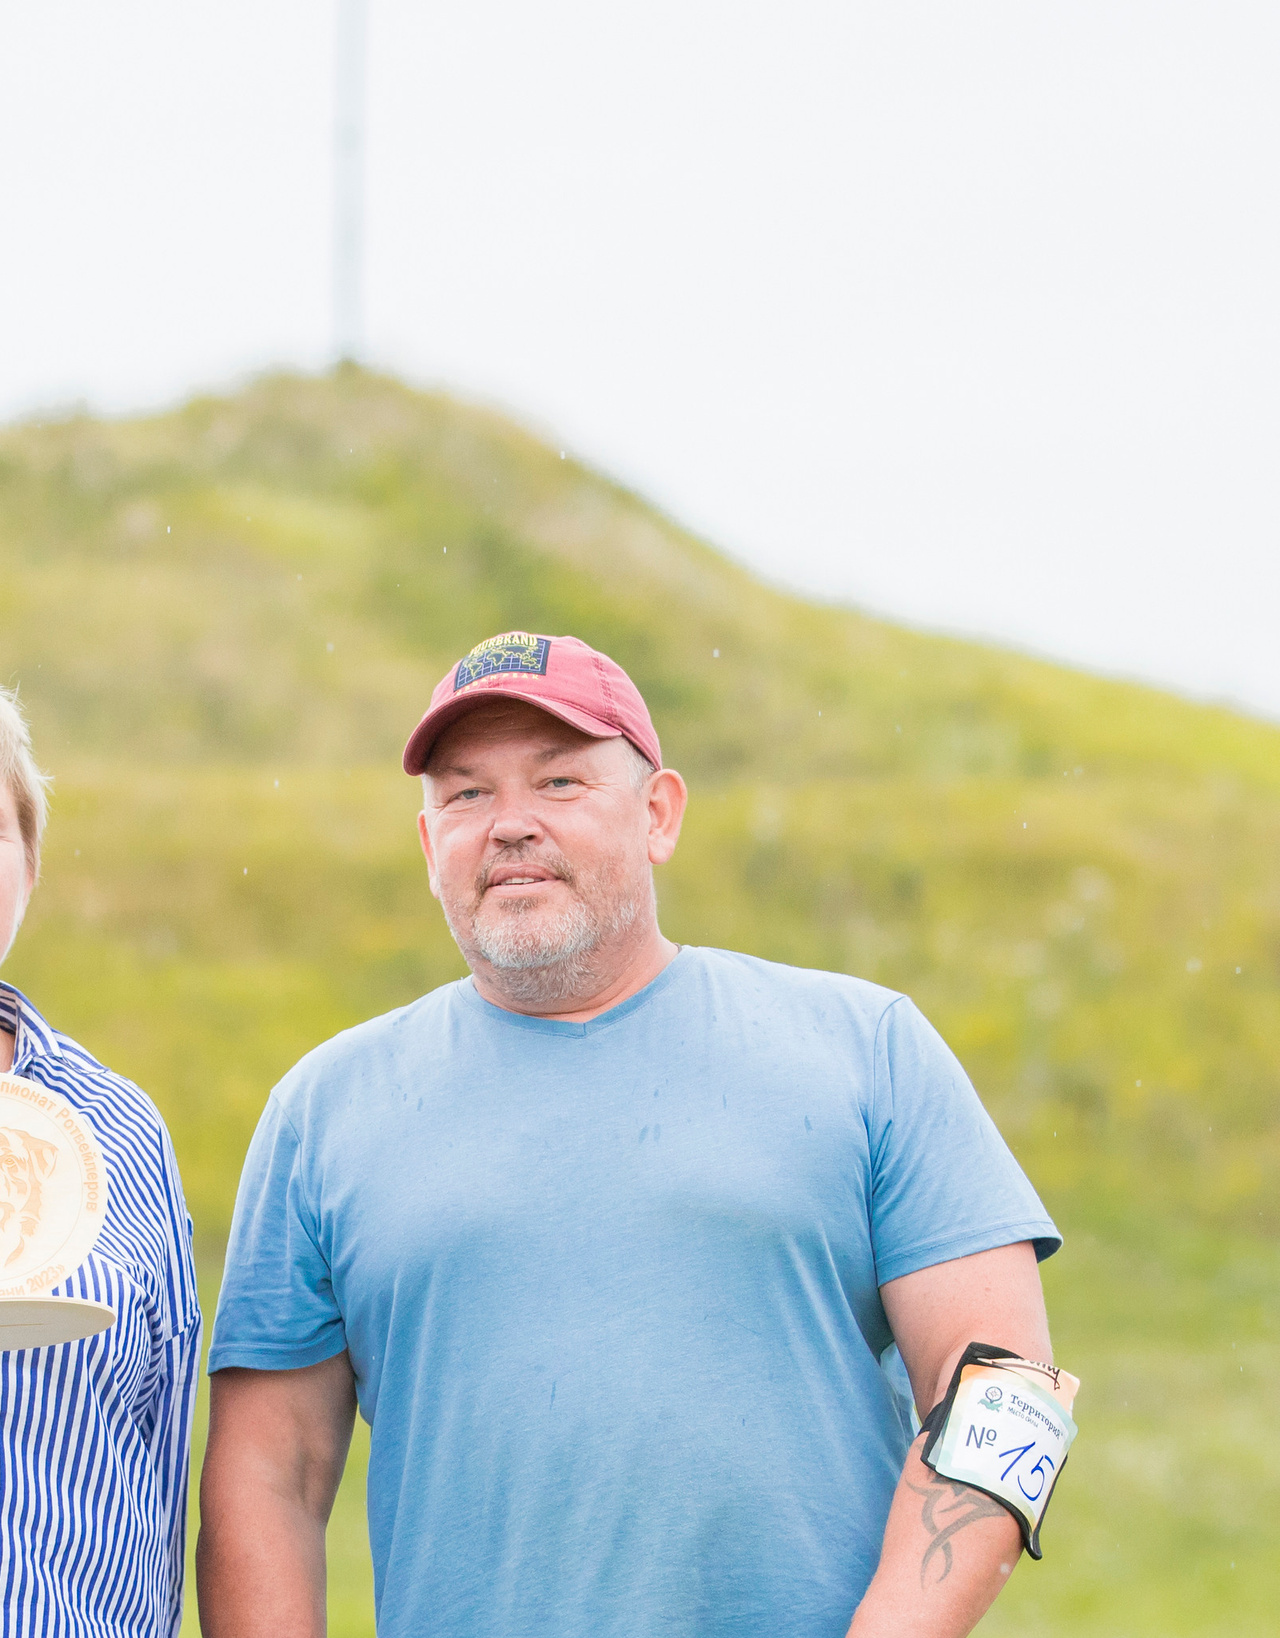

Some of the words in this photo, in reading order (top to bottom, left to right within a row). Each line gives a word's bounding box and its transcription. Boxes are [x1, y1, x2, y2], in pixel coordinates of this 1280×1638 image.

[55, 1107, 99, 1213] Ротвейлеров
[965, 1424, 998, 1450] №
[999, 1441, 1056, 1502] 15
